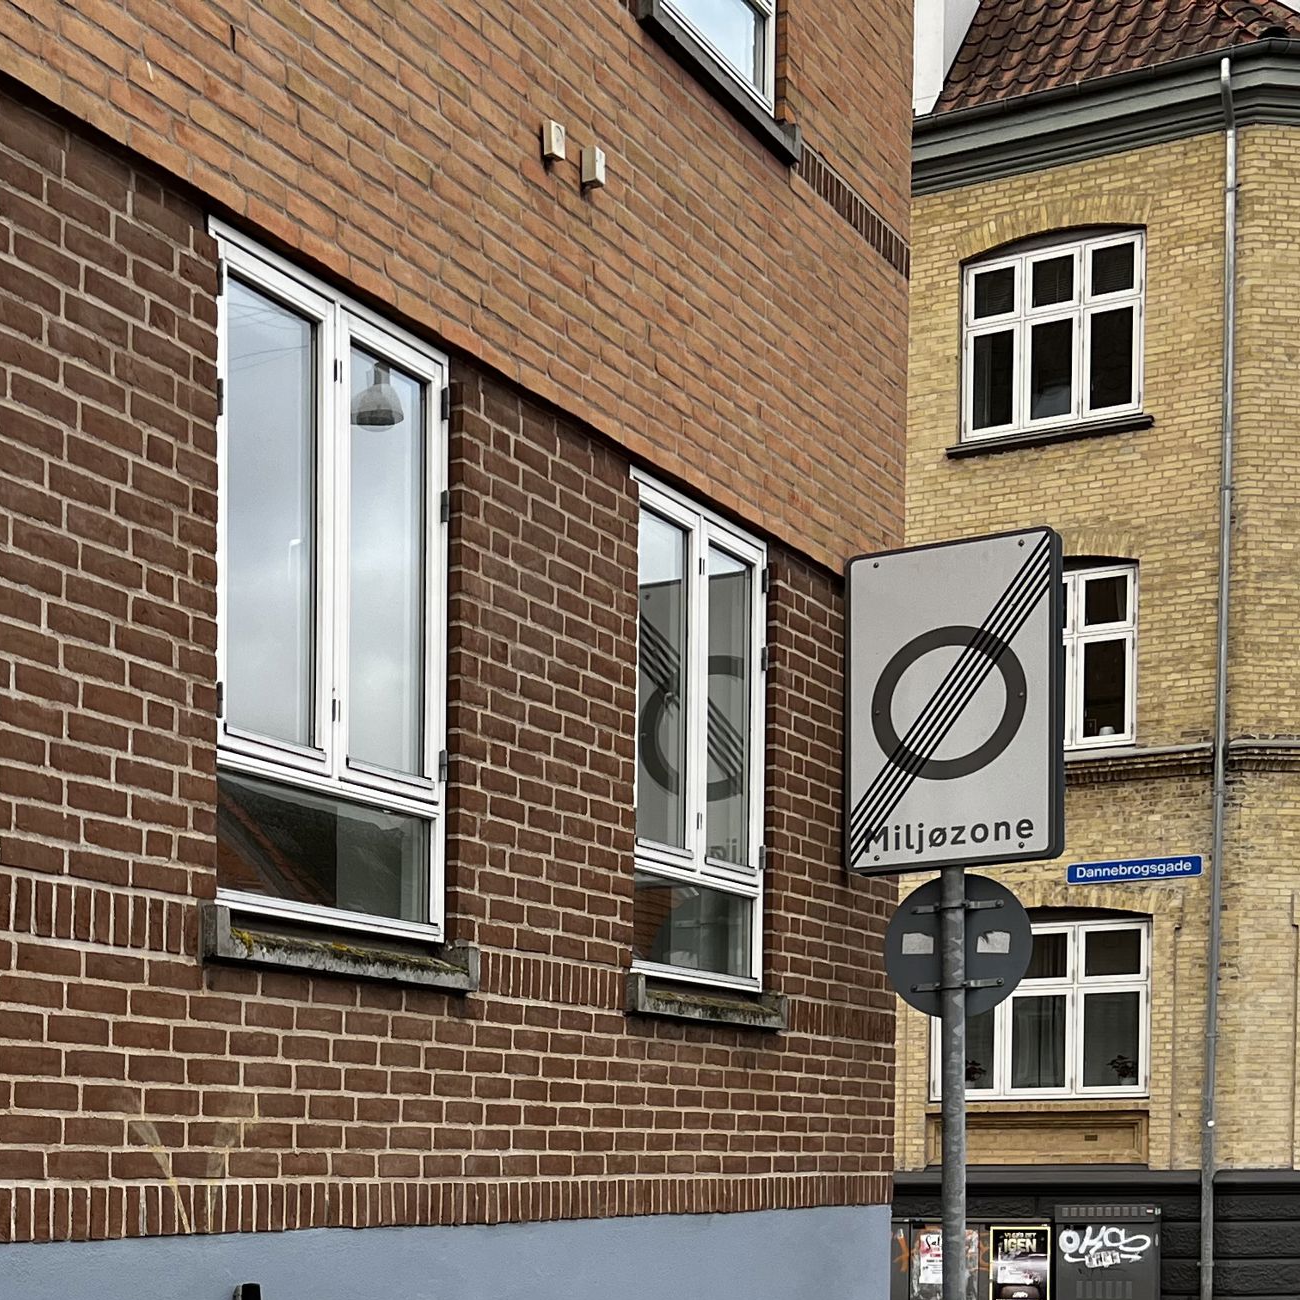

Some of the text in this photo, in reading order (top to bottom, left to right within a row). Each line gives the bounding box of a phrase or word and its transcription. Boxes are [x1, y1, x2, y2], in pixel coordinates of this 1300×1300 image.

[865, 818, 1034, 855] Miljøzone
[1076, 860, 1192, 878] Dannebrogsgade
[1004, 1238, 1037, 1253] IGEN
